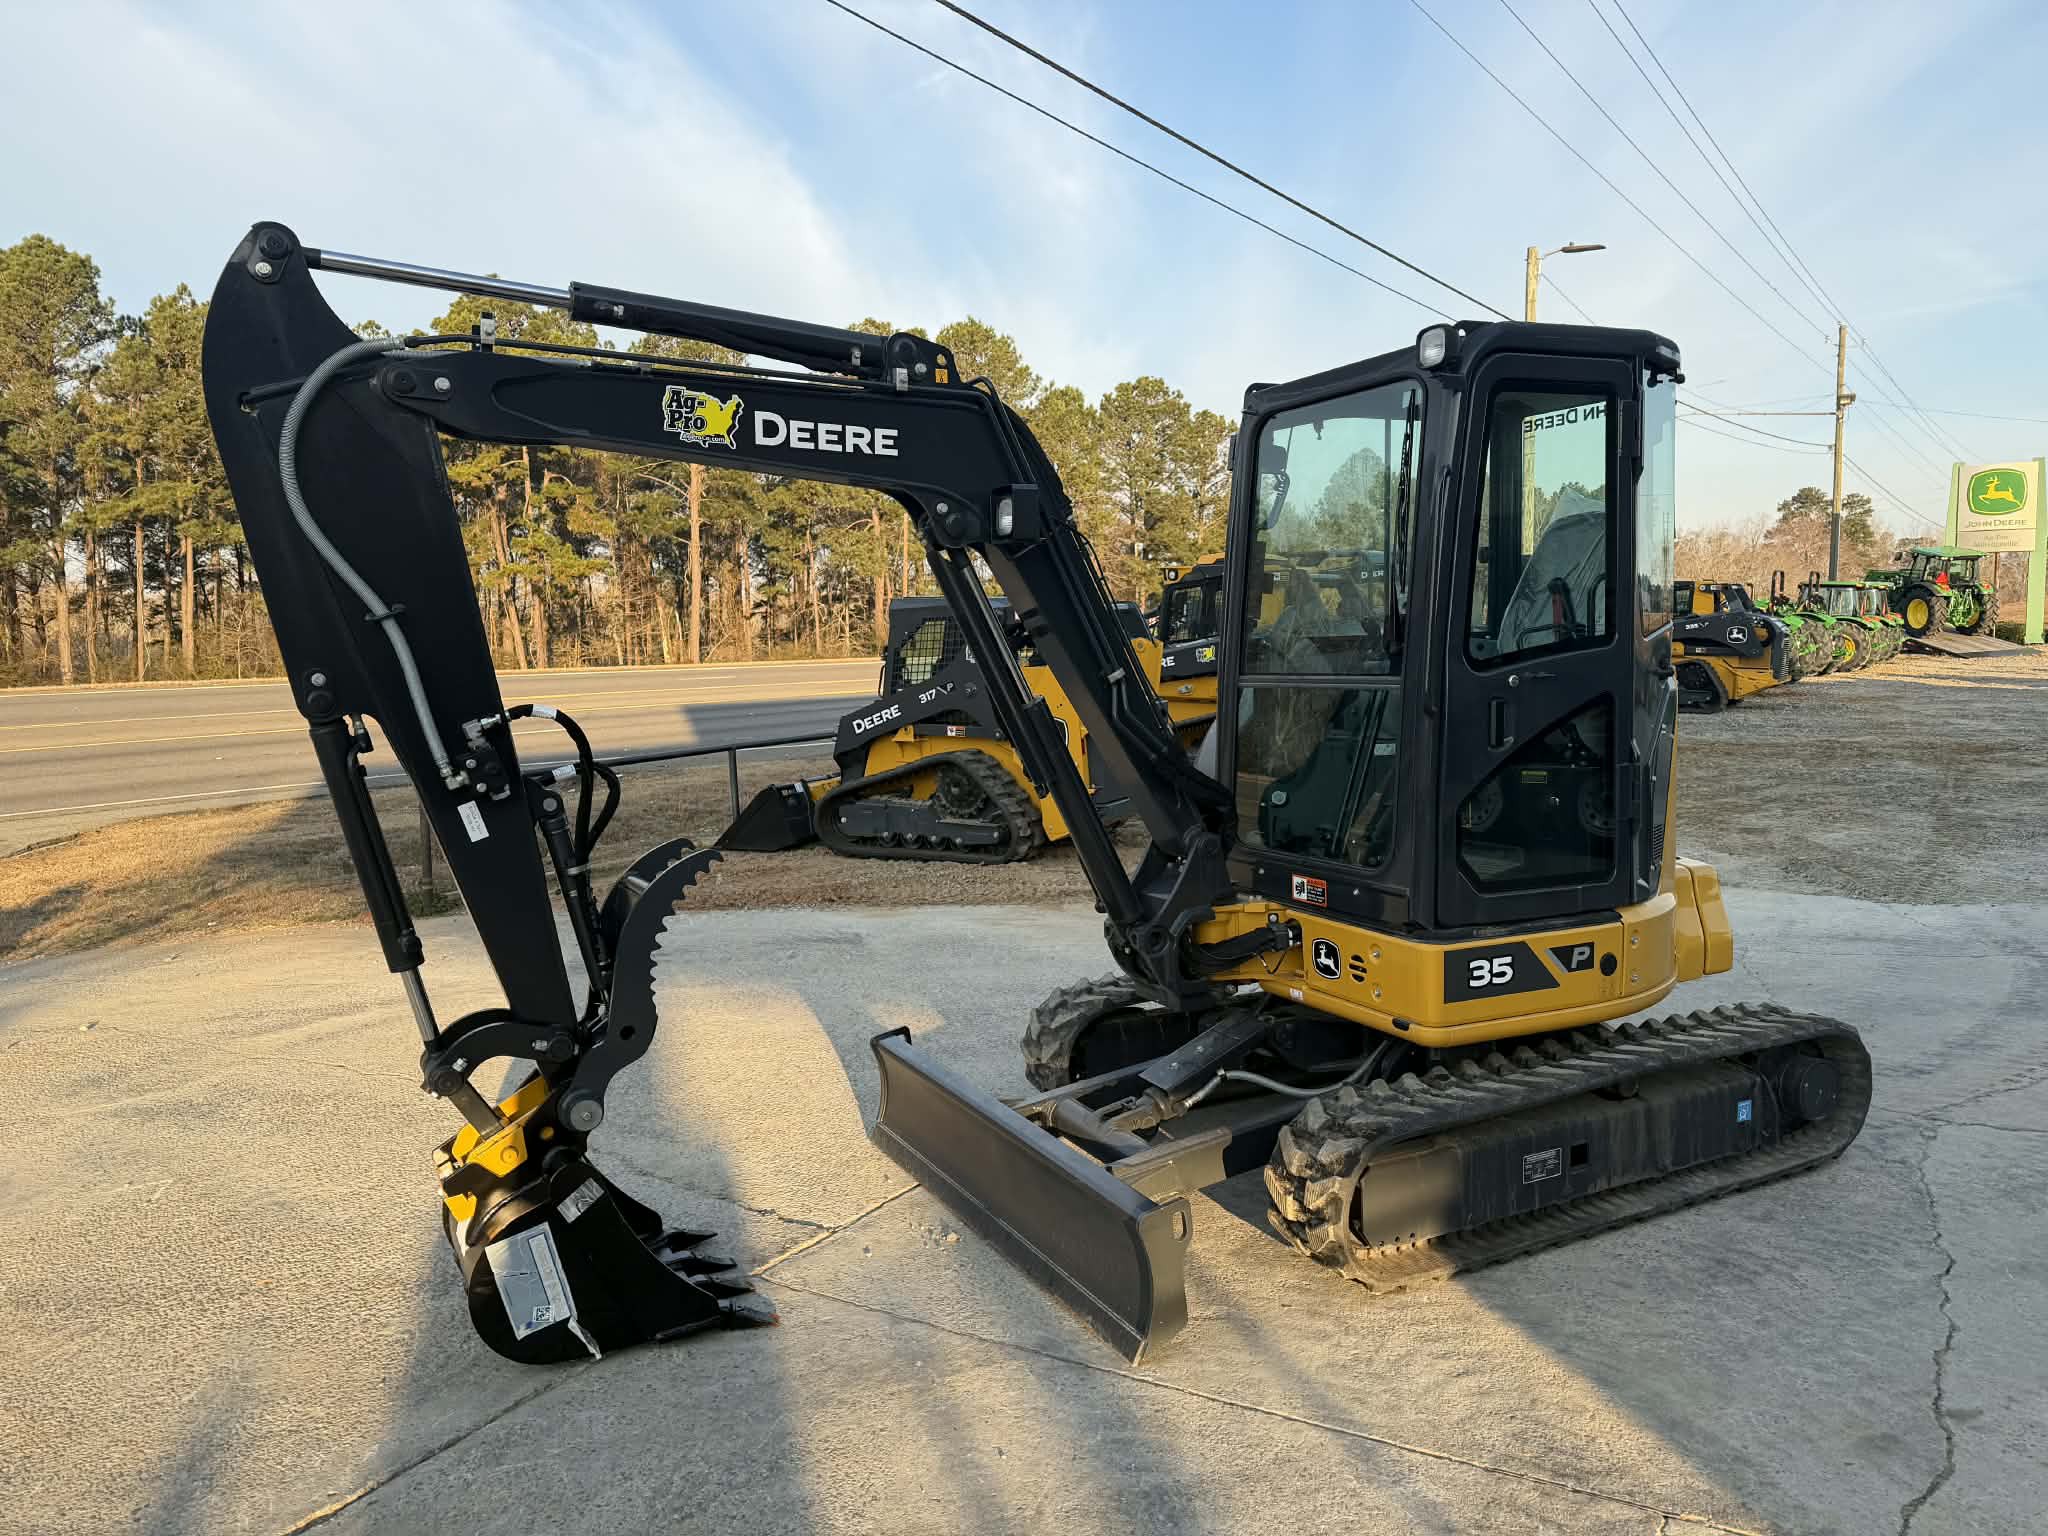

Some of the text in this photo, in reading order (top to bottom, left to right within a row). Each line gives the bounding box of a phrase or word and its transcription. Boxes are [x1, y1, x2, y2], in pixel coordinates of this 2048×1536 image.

[666, 409, 707, 430] Pro
[754, 411, 899, 456] DEERE
[918, 688, 937, 704] 317
[852, 704, 902, 735] DEERE
[1468, 945, 1591, 987] 35 P
